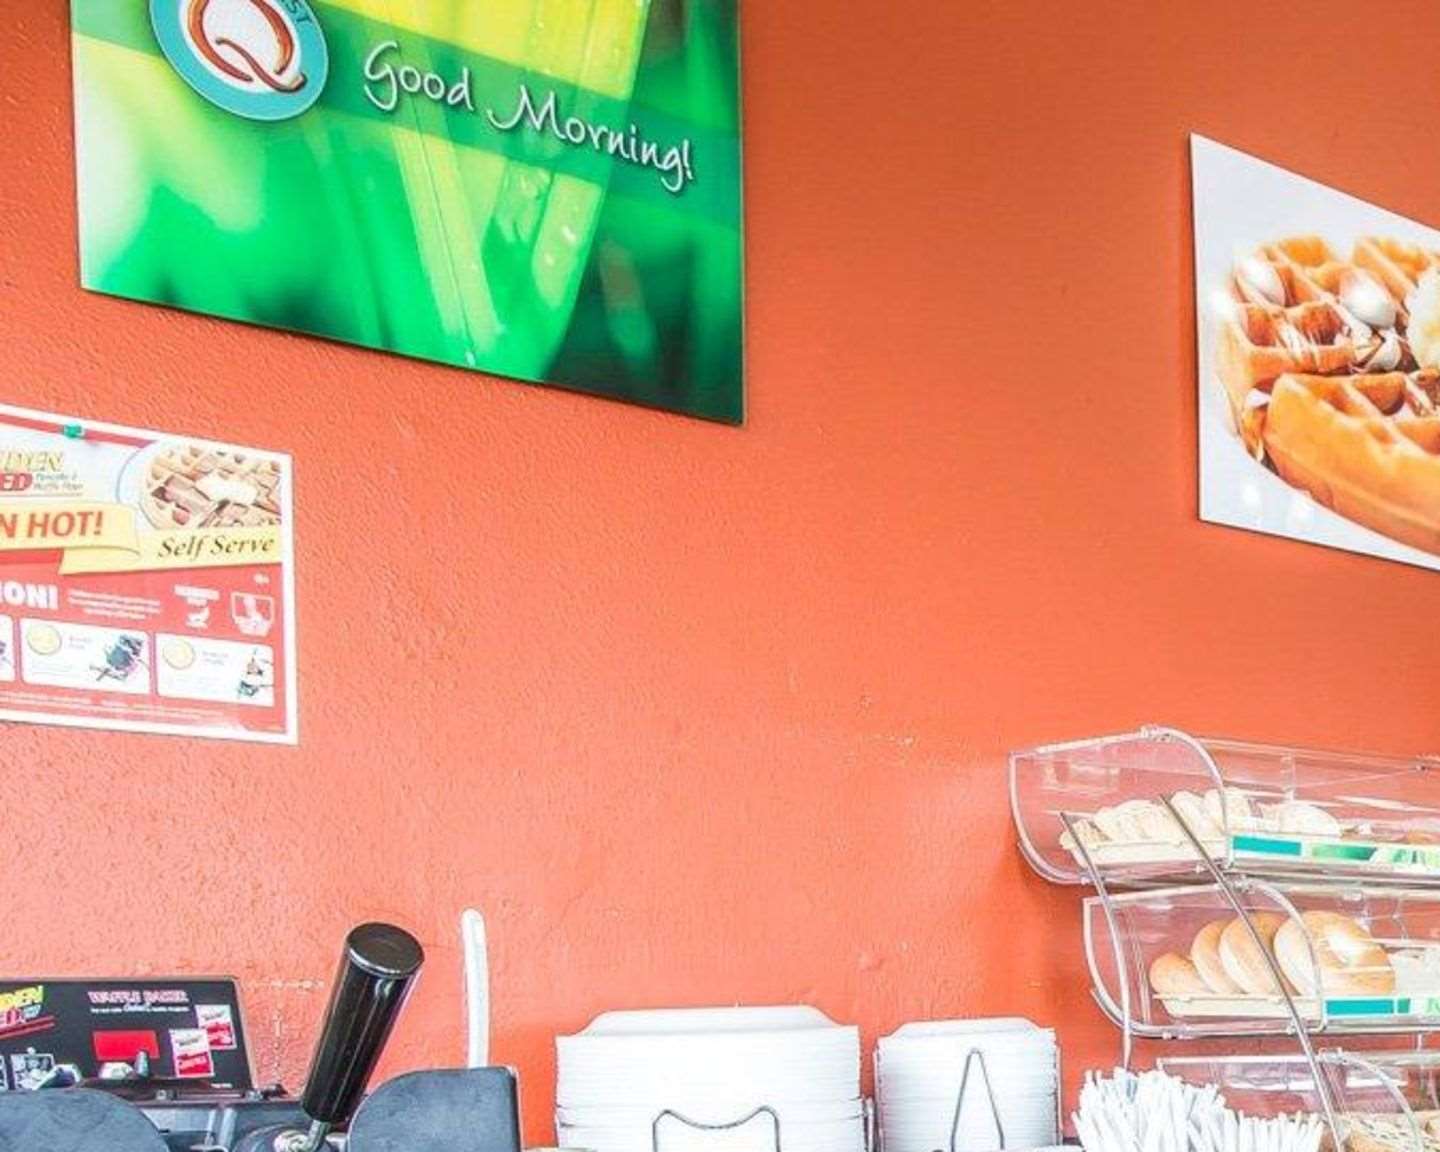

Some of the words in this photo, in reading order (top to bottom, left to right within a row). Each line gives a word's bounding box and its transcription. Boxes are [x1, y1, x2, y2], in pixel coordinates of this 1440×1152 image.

[363, 41, 474, 112] Good
[486, 85, 694, 193] Morning!
[26, 510, 103, 538] HOT!
[158, 535, 210, 562] Self
[210, 535, 275, 555] Serve
